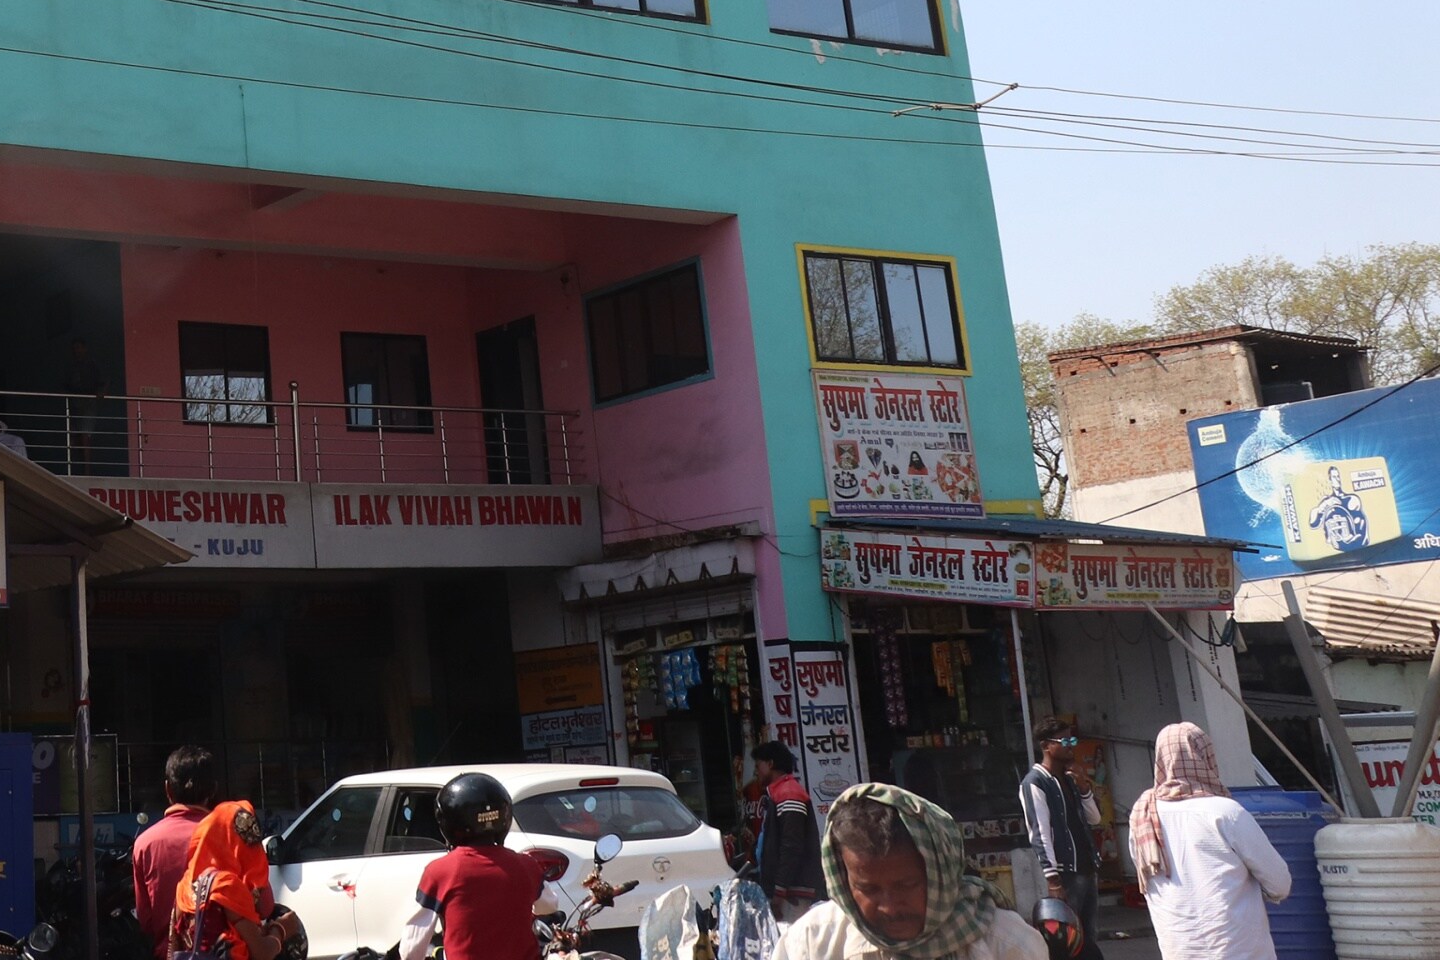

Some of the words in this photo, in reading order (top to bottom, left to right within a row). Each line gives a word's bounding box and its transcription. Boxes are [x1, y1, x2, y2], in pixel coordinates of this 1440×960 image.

[819, 385, 868, 432] सुषमा
[870, 378, 924, 422] जेनरल
[927, 380, 962, 423] स्टोर
[1353, 478, 1385, 490] KAWACH
[397, 495, 473, 526] VIVAH
[477, 496, 582, 526] BHAWAN
[207, 538, 263, 556] KUJU
[853, 541, 902, 586] सुषमा
[908, 536, 965, 580] जेनरल
[970, 540, 1010, 584] स्टोर
[1070, 554, 1118, 598] सुषमा
[1122, 548, 1175, 589] जेनरल
[1181, 549, 1215, 588] स्टोर
[796, 660, 845, 697] सुषमा
[529, 716, 560, 734] होटल
[801, 700, 848, 726] जेनरल
[806, 729, 850, 753] स्टोर
